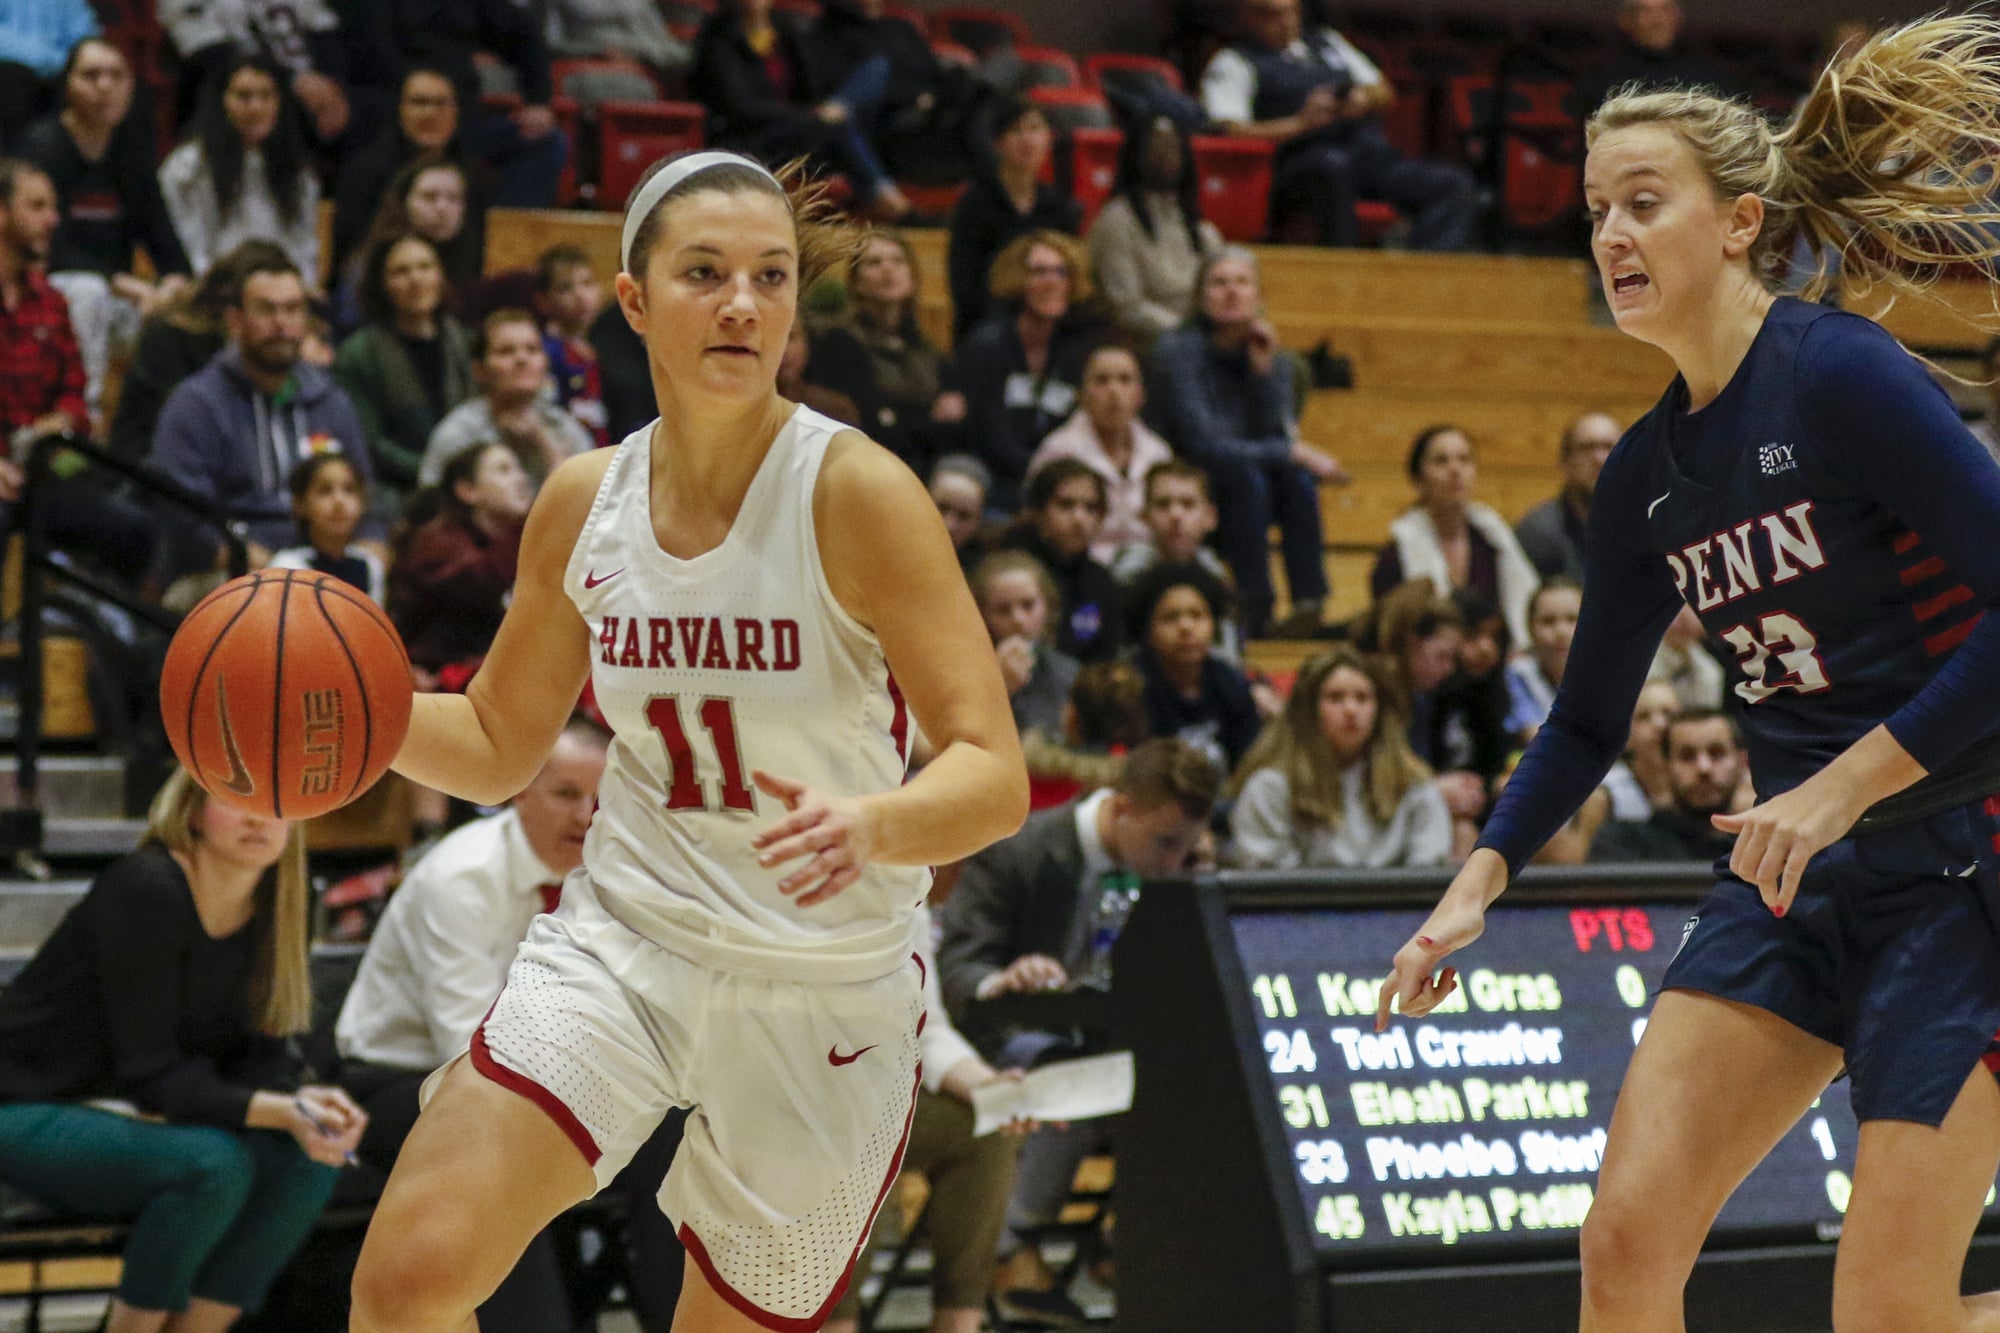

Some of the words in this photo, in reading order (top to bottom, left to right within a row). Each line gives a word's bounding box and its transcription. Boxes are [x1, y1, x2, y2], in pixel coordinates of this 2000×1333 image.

[1769, 444, 1794, 467] IVY
[1772, 460, 1799, 475] LEGUE
[599, 616, 801, 671] HARVARD
[301, 689, 334, 796] ELITE
[642, 693, 759, 817] 11
[1568, 908, 1655, 952] PTS
[1253, 973, 1298, 1018] 11
[1469, 968, 1563, 1012] Gras
[1616, 963, 1647, 1008] 0
[1264, 1030, 1317, 1073] 24
[1279, 1084, 1329, 1128] 31
[1462, 1075, 1590, 1122] Parker
[1296, 1139, 1349, 1184] 33
[1366, 1132, 1518, 1181] Phoebe
[1811, 1116, 1837, 1161] 1
[1315, 1193, 1365, 1240] 45
[1382, 1189, 1494, 1245] Kayla
[1825, 1170, 1852, 1213] 0
